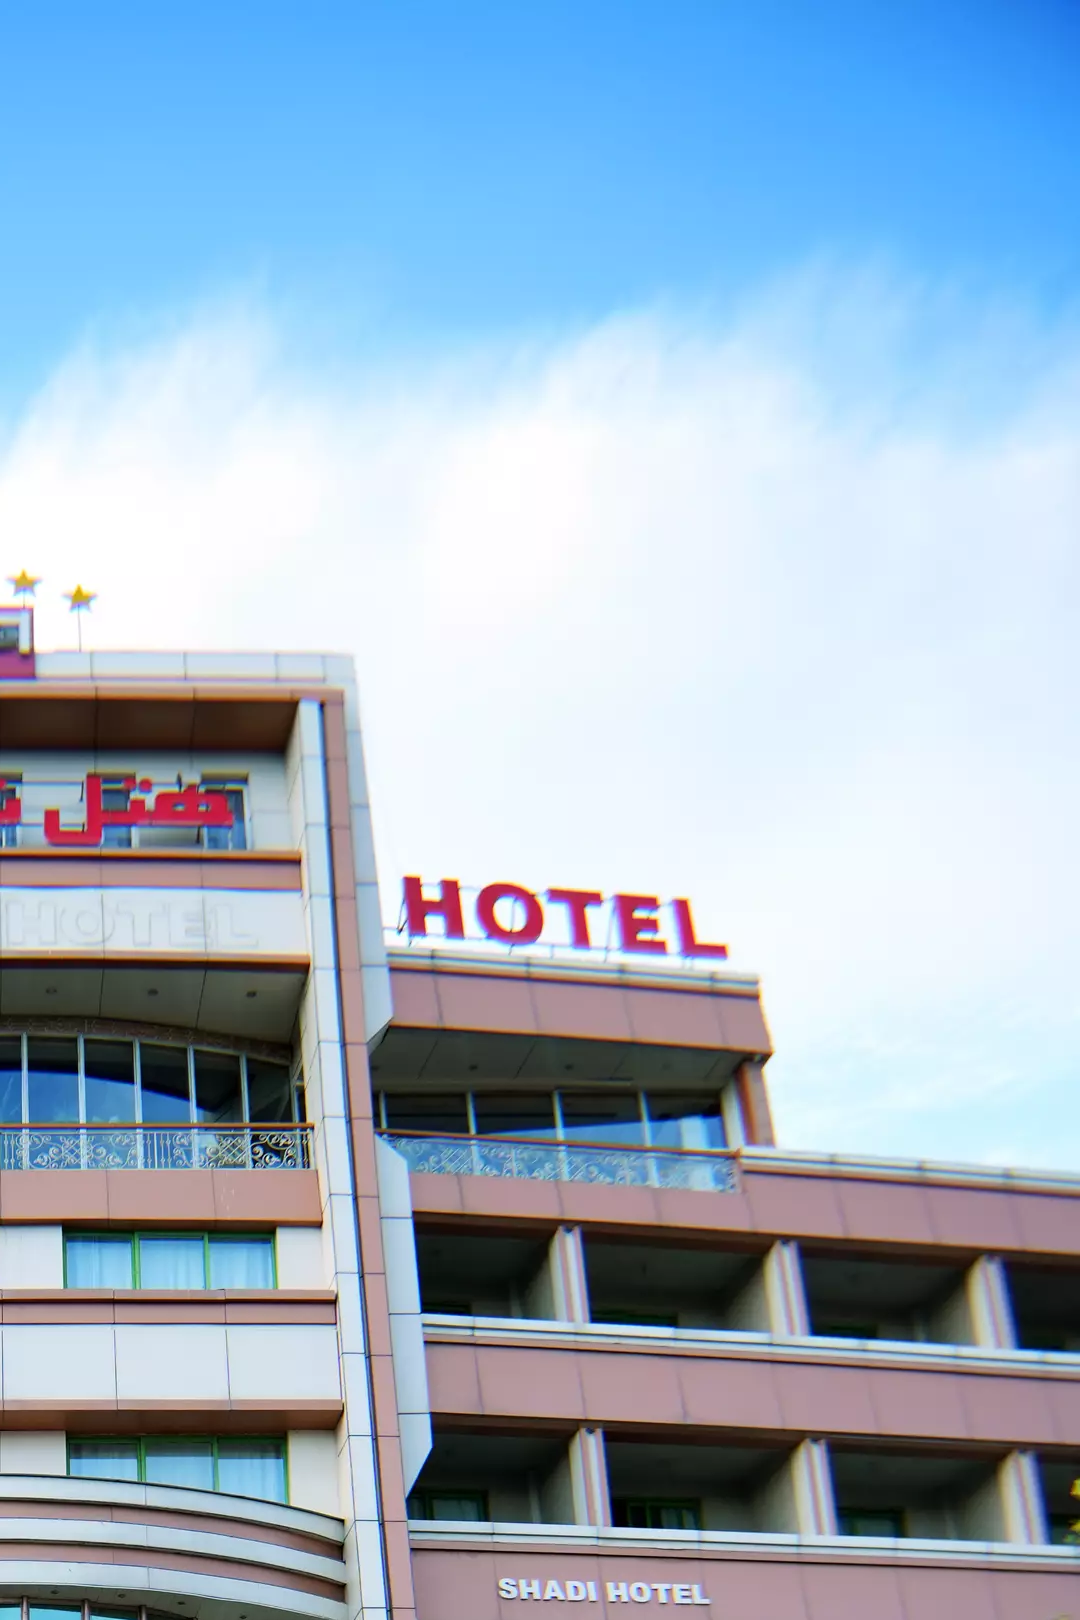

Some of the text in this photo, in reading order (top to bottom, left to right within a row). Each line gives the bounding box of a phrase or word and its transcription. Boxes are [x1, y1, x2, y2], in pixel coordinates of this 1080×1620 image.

[45, 772, 234, 846] هتل
[5, 899, 259, 948] HOTEL
[402, 875, 728, 959] HOTEL
[498, 1578, 712, 1605] SHADI HOTEL
